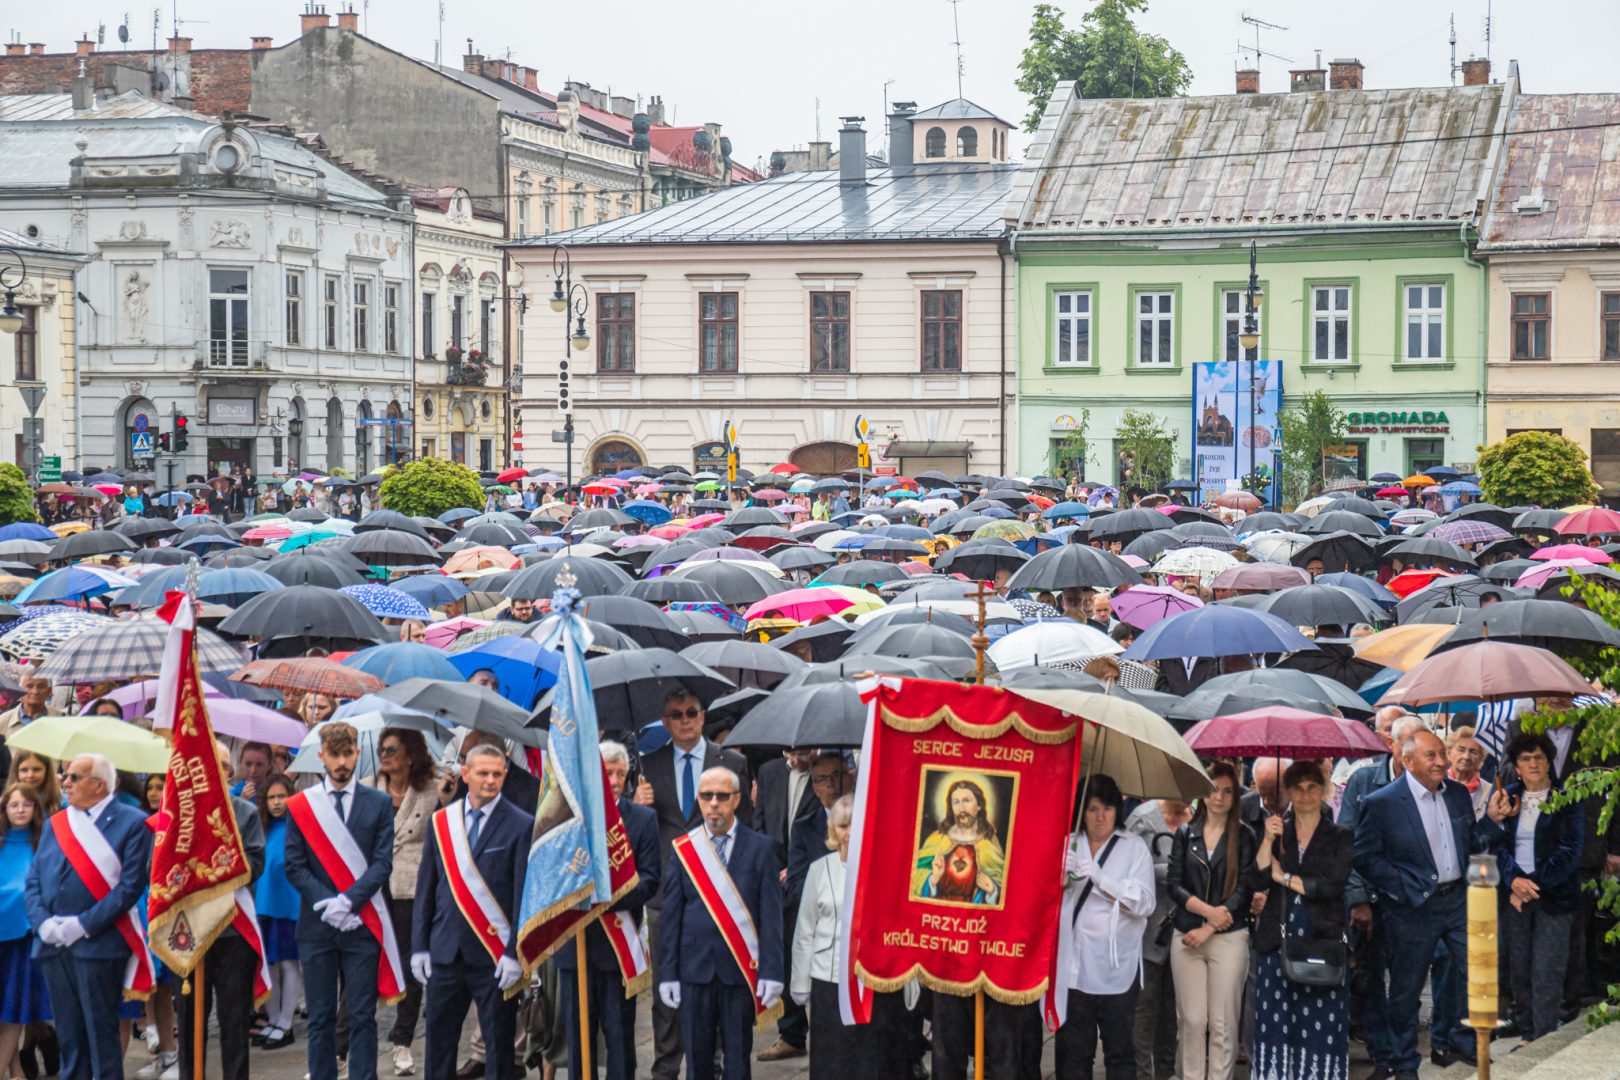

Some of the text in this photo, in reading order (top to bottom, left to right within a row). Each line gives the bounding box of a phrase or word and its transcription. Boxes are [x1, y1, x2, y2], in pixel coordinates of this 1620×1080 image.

[1348, 411, 1449, 425] GROMADA
[1348, 426, 1450, 434] BIURO TURYSTYCZNE
[913, 739, 1034, 763] SERCE JEZUSA
[186, 756, 210, 795] CECH
[922, 914, 987, 934] PRZYJDŹ
[883, 928, 1026, 957] KRÓLESTWO TWOJE
